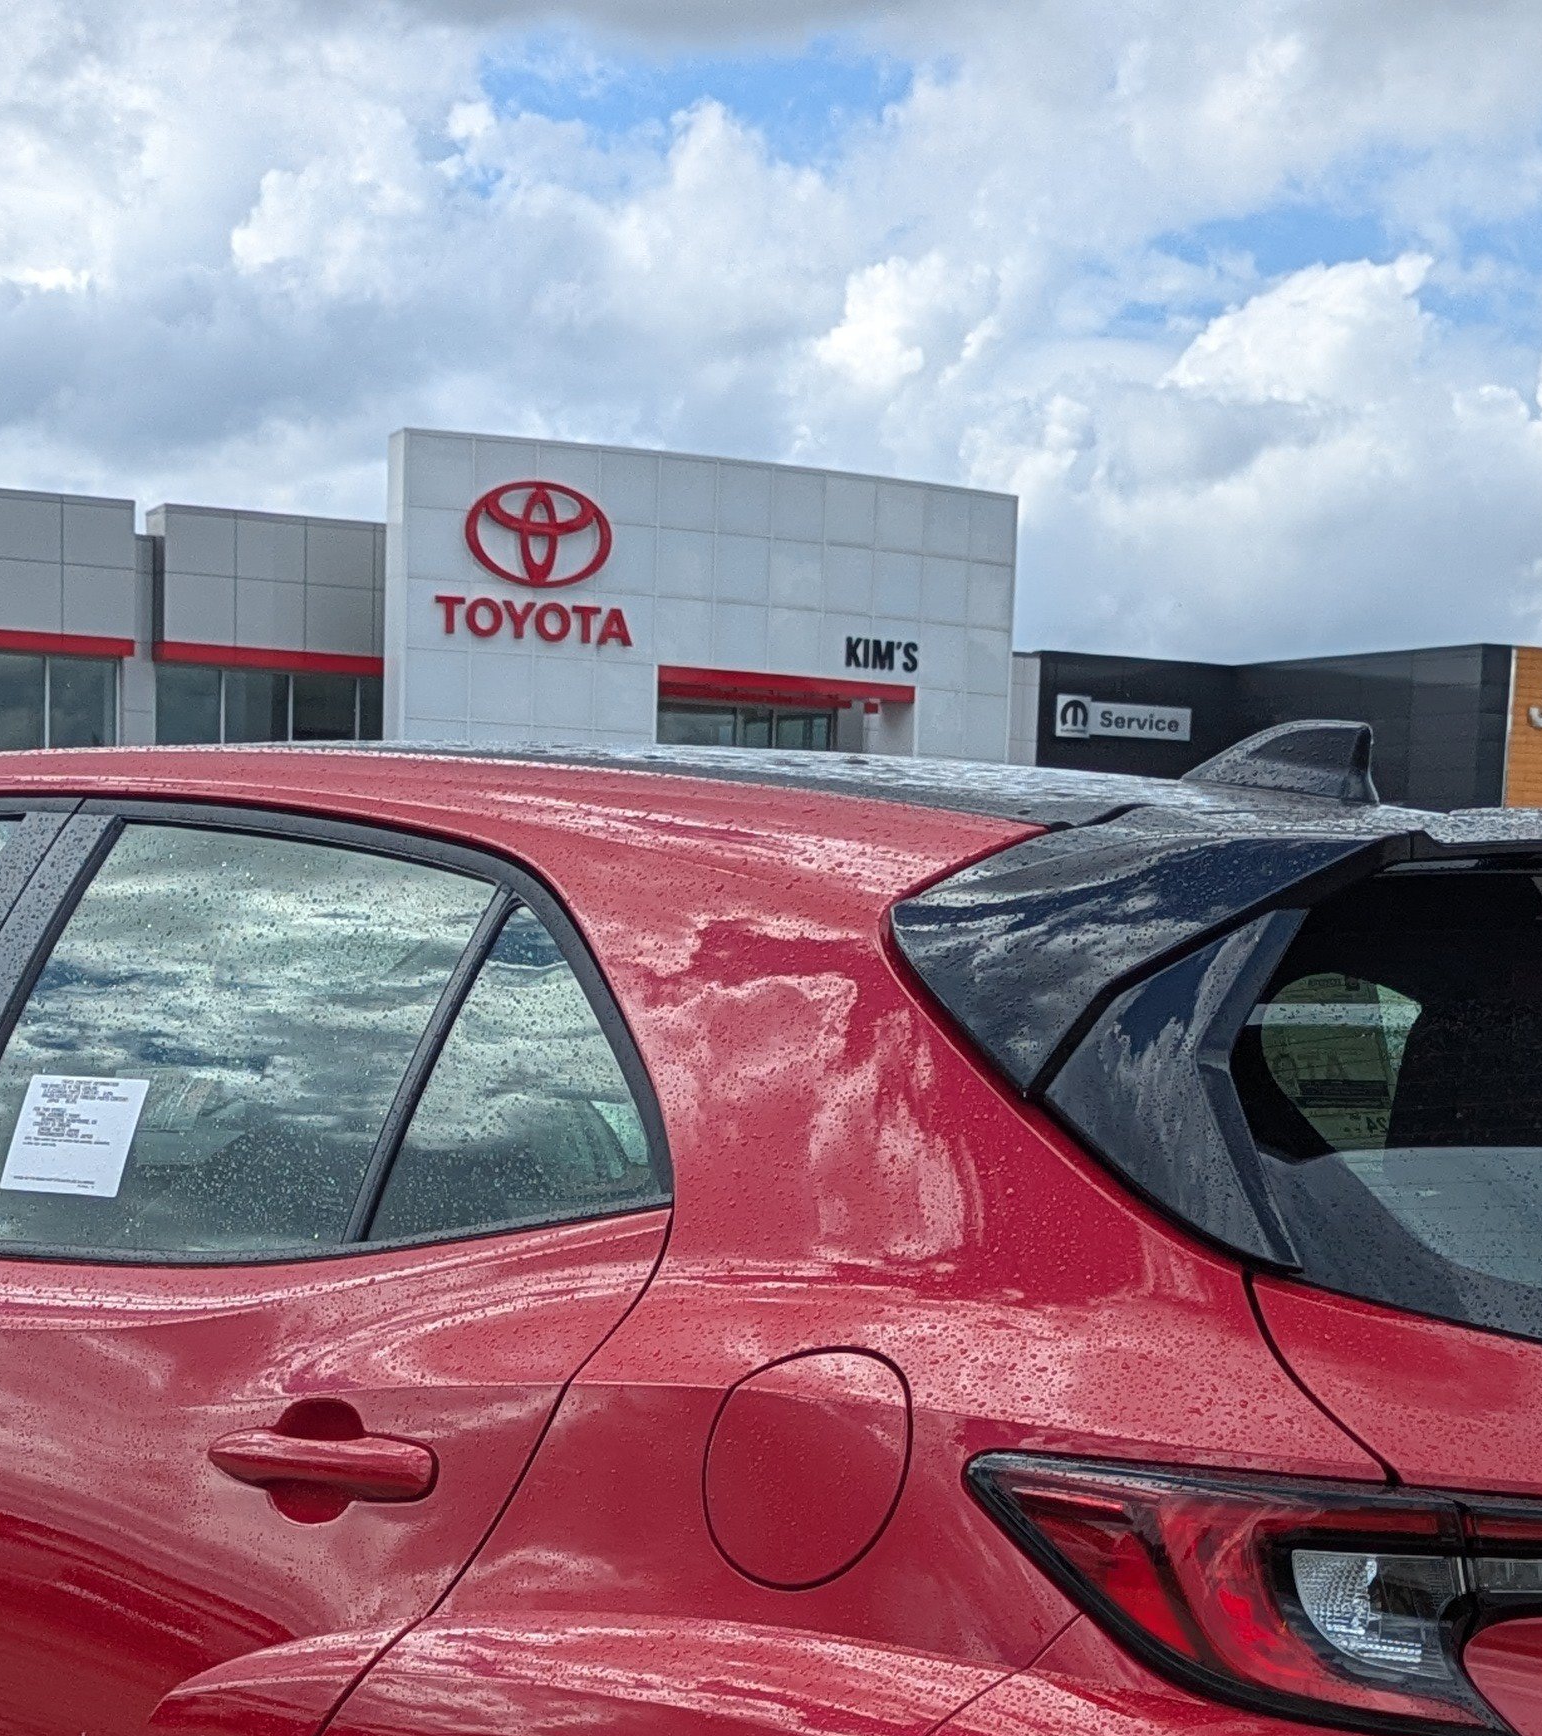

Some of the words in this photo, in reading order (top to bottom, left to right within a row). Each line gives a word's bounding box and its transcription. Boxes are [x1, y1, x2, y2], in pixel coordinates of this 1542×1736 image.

[434, 594, 633, 647] TOYOTA
[845, 636, 918, 673] KIM'S
[1100, 710, 1179, 732] Service
